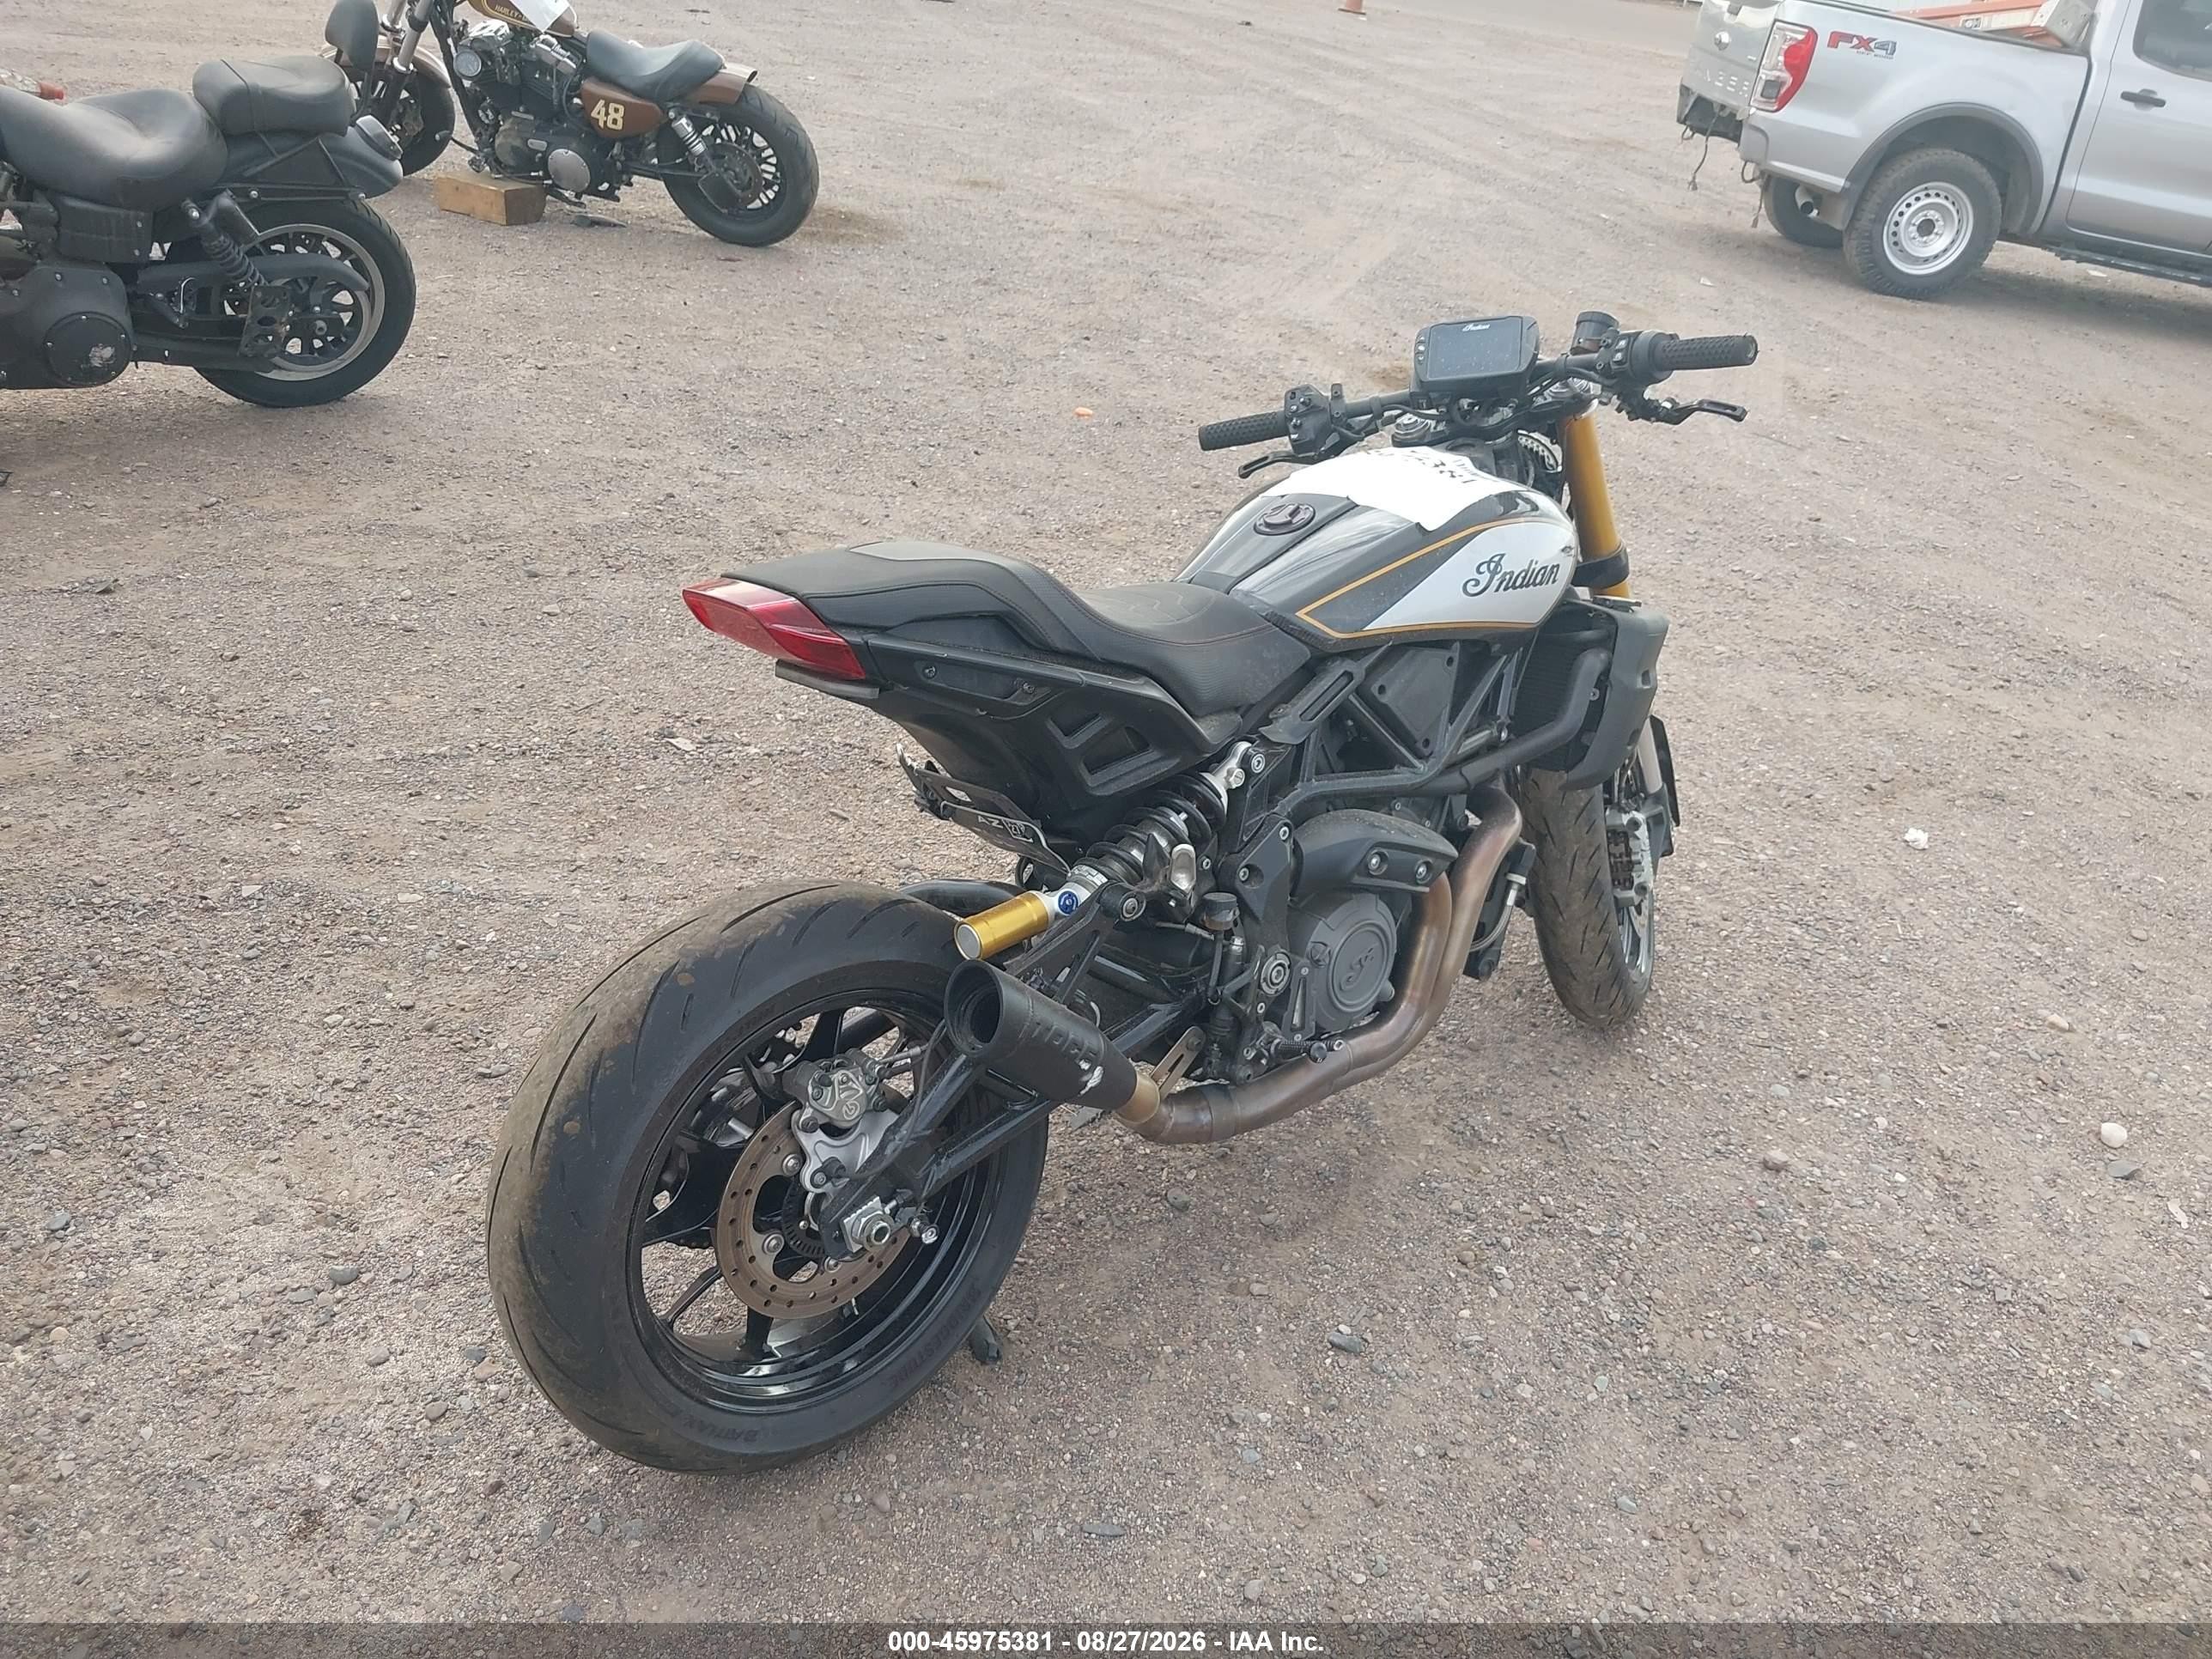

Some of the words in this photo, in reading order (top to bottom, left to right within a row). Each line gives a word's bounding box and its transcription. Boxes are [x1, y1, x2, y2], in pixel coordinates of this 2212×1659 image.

[1826, 31, 1898, 57] FX4
[590, 99, 625, 131] 48
[1462, 552, 1561, 598] Indian
